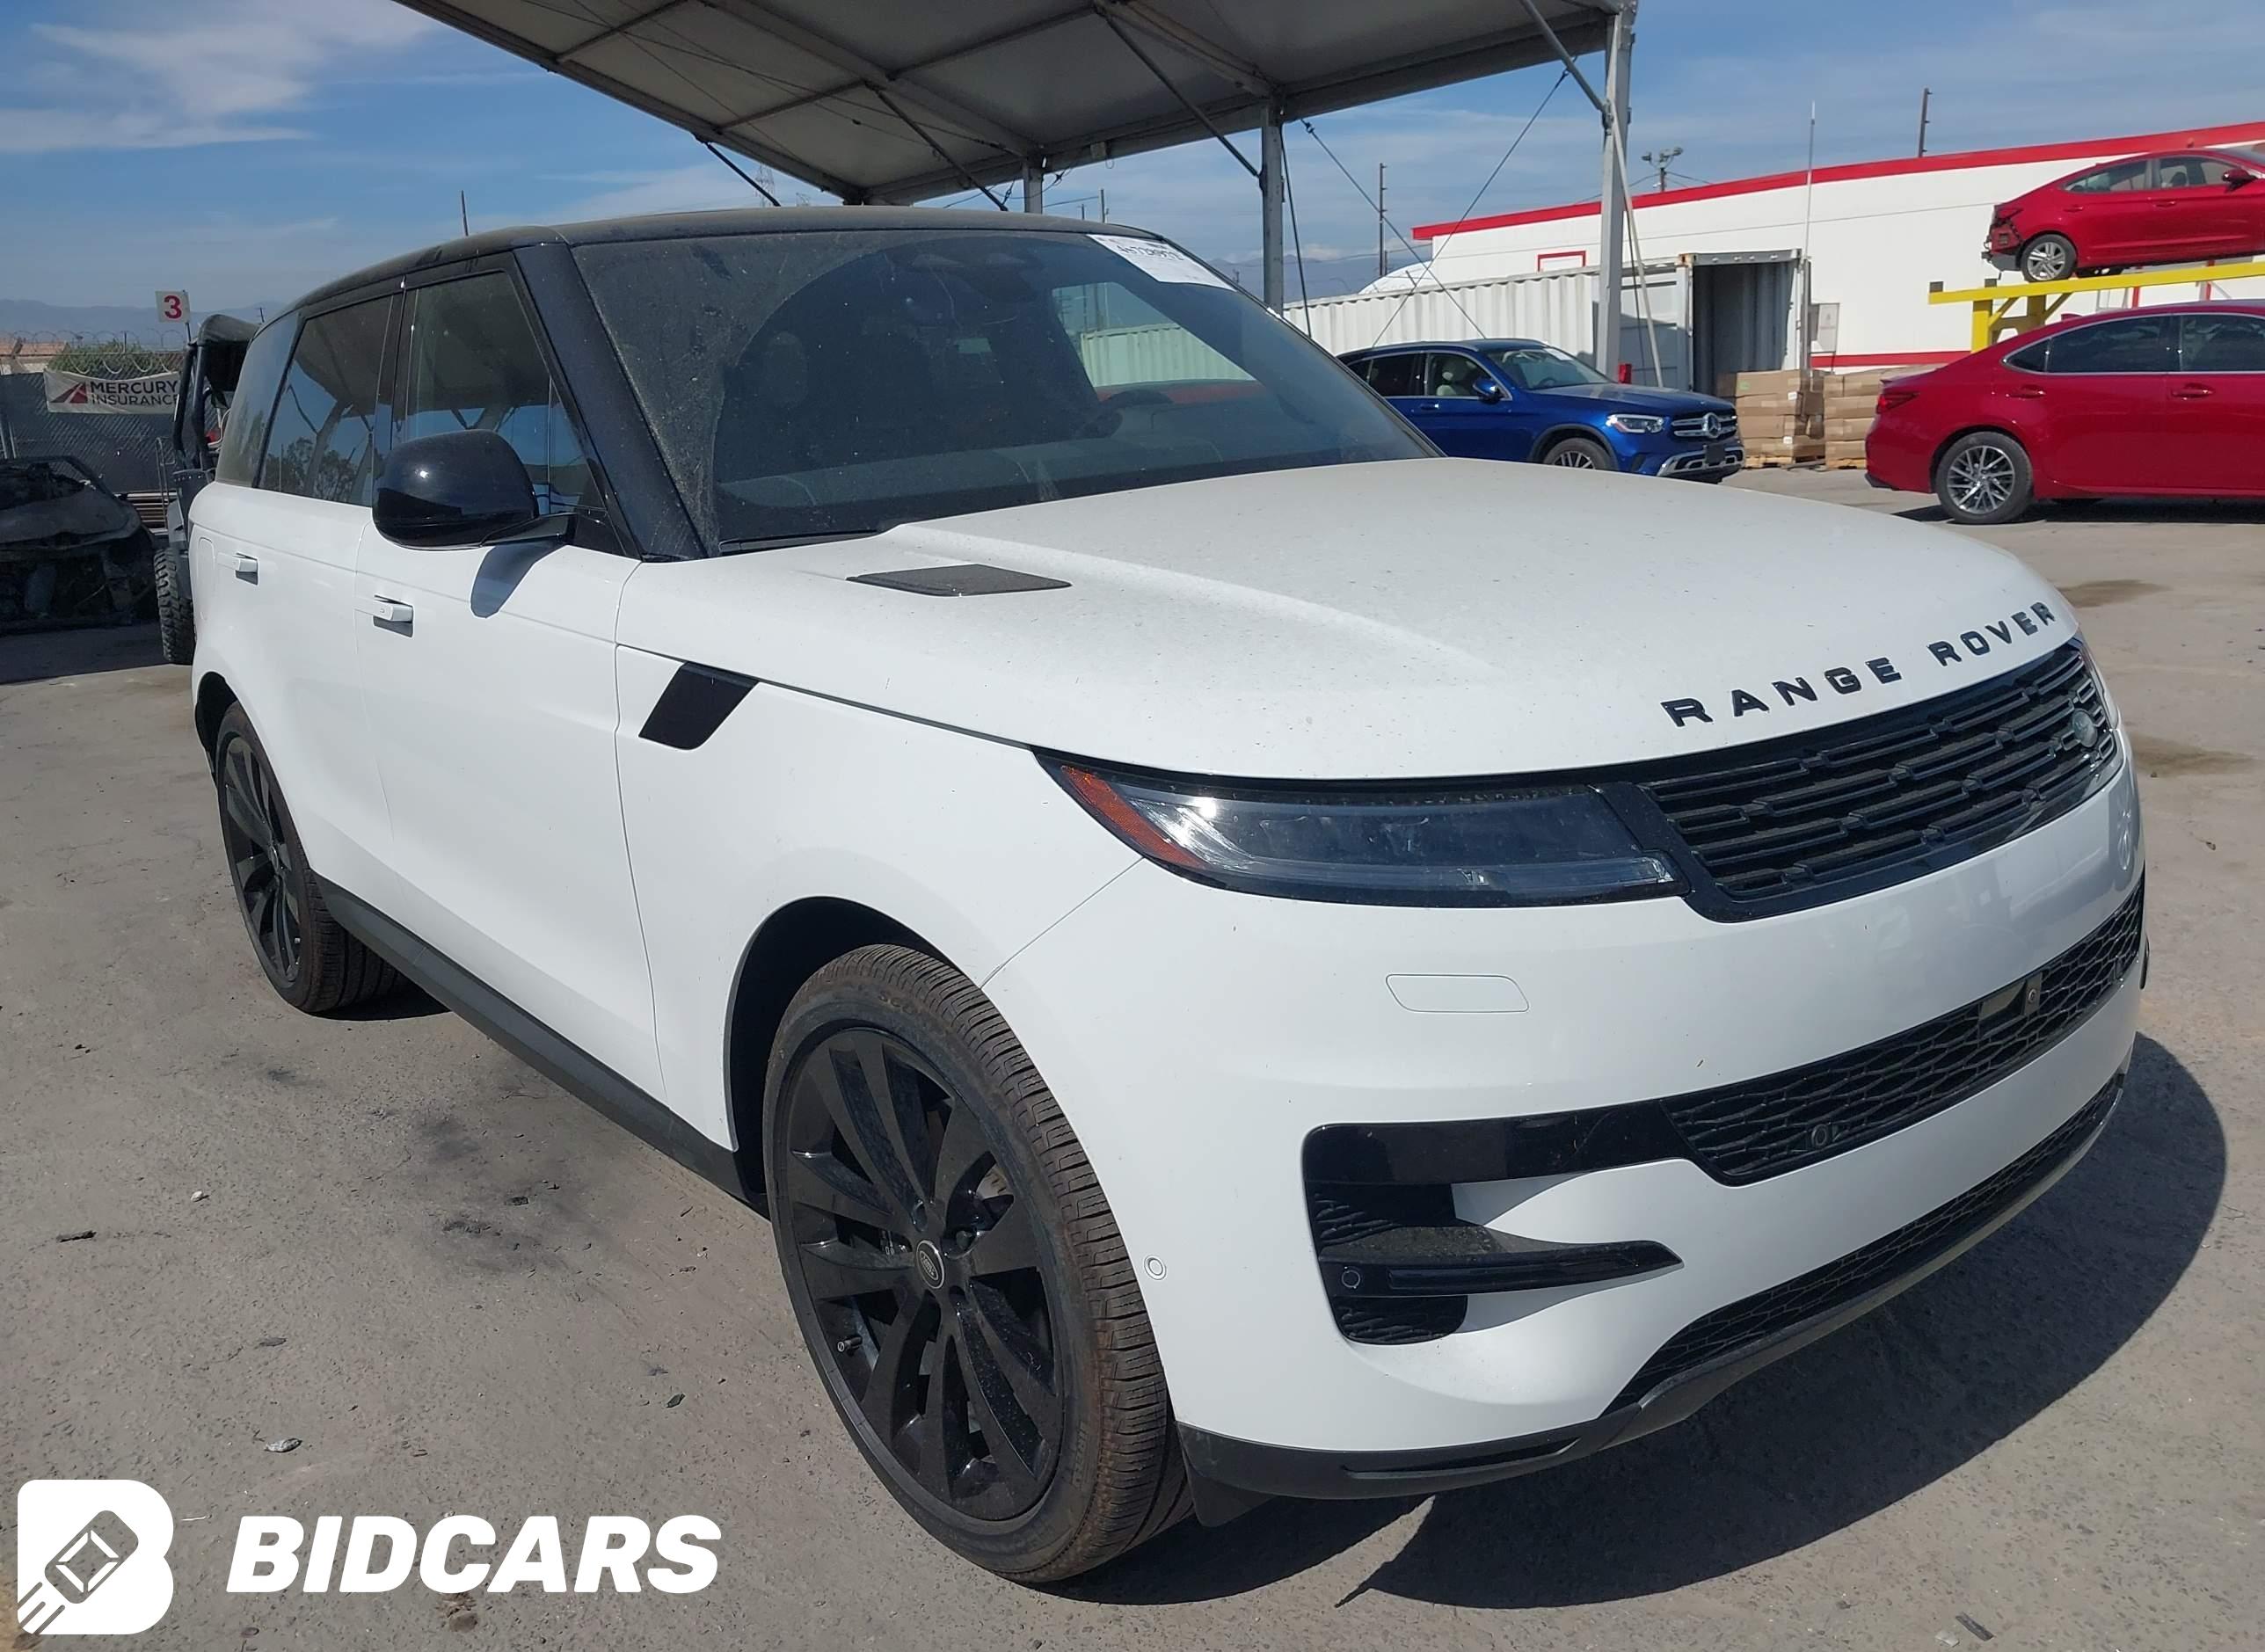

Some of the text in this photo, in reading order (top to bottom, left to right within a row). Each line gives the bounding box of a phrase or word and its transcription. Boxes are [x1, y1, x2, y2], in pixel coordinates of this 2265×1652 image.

[164, 295, 182, 319] 3
[91, 381, 178, 394] MERCURY
[1660, 601, 2057, 728] RANGE ROVER
